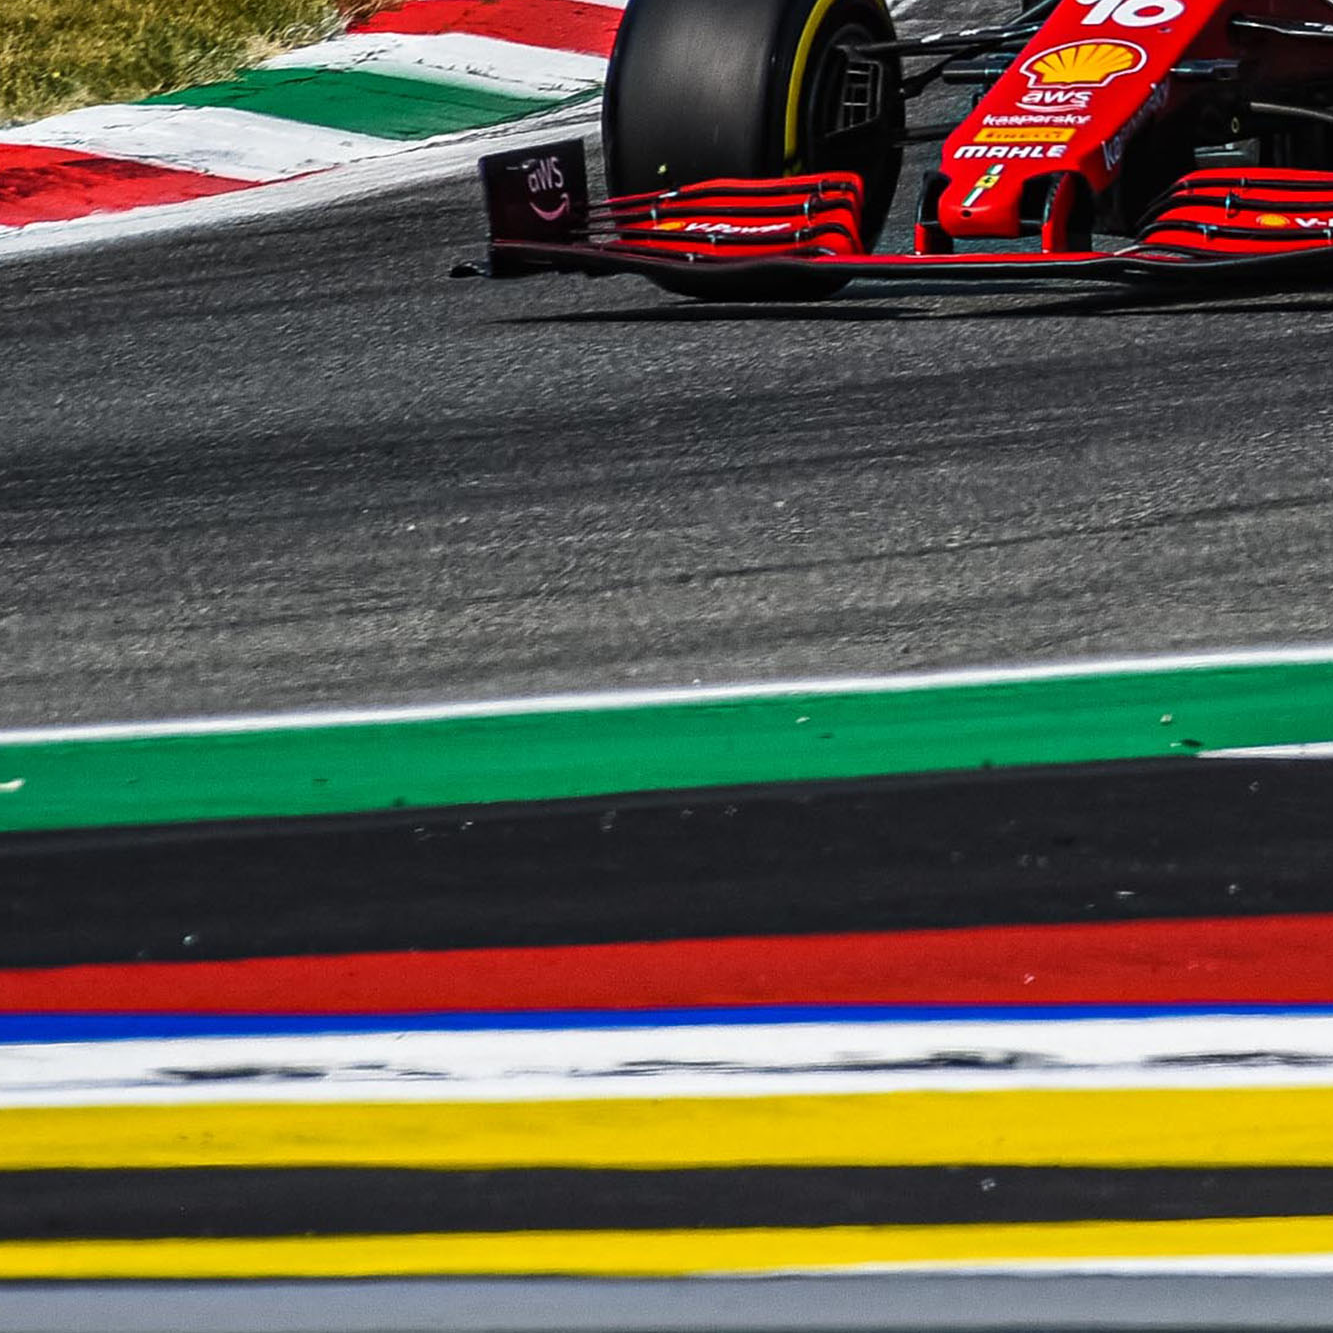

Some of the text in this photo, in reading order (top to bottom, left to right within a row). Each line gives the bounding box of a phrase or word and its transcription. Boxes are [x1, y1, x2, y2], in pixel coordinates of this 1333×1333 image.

[982, 114, 1092, 126] kaspersky
[953, 145, 1067, 159] MAHLE
[528, 156, 564, 193] aws
